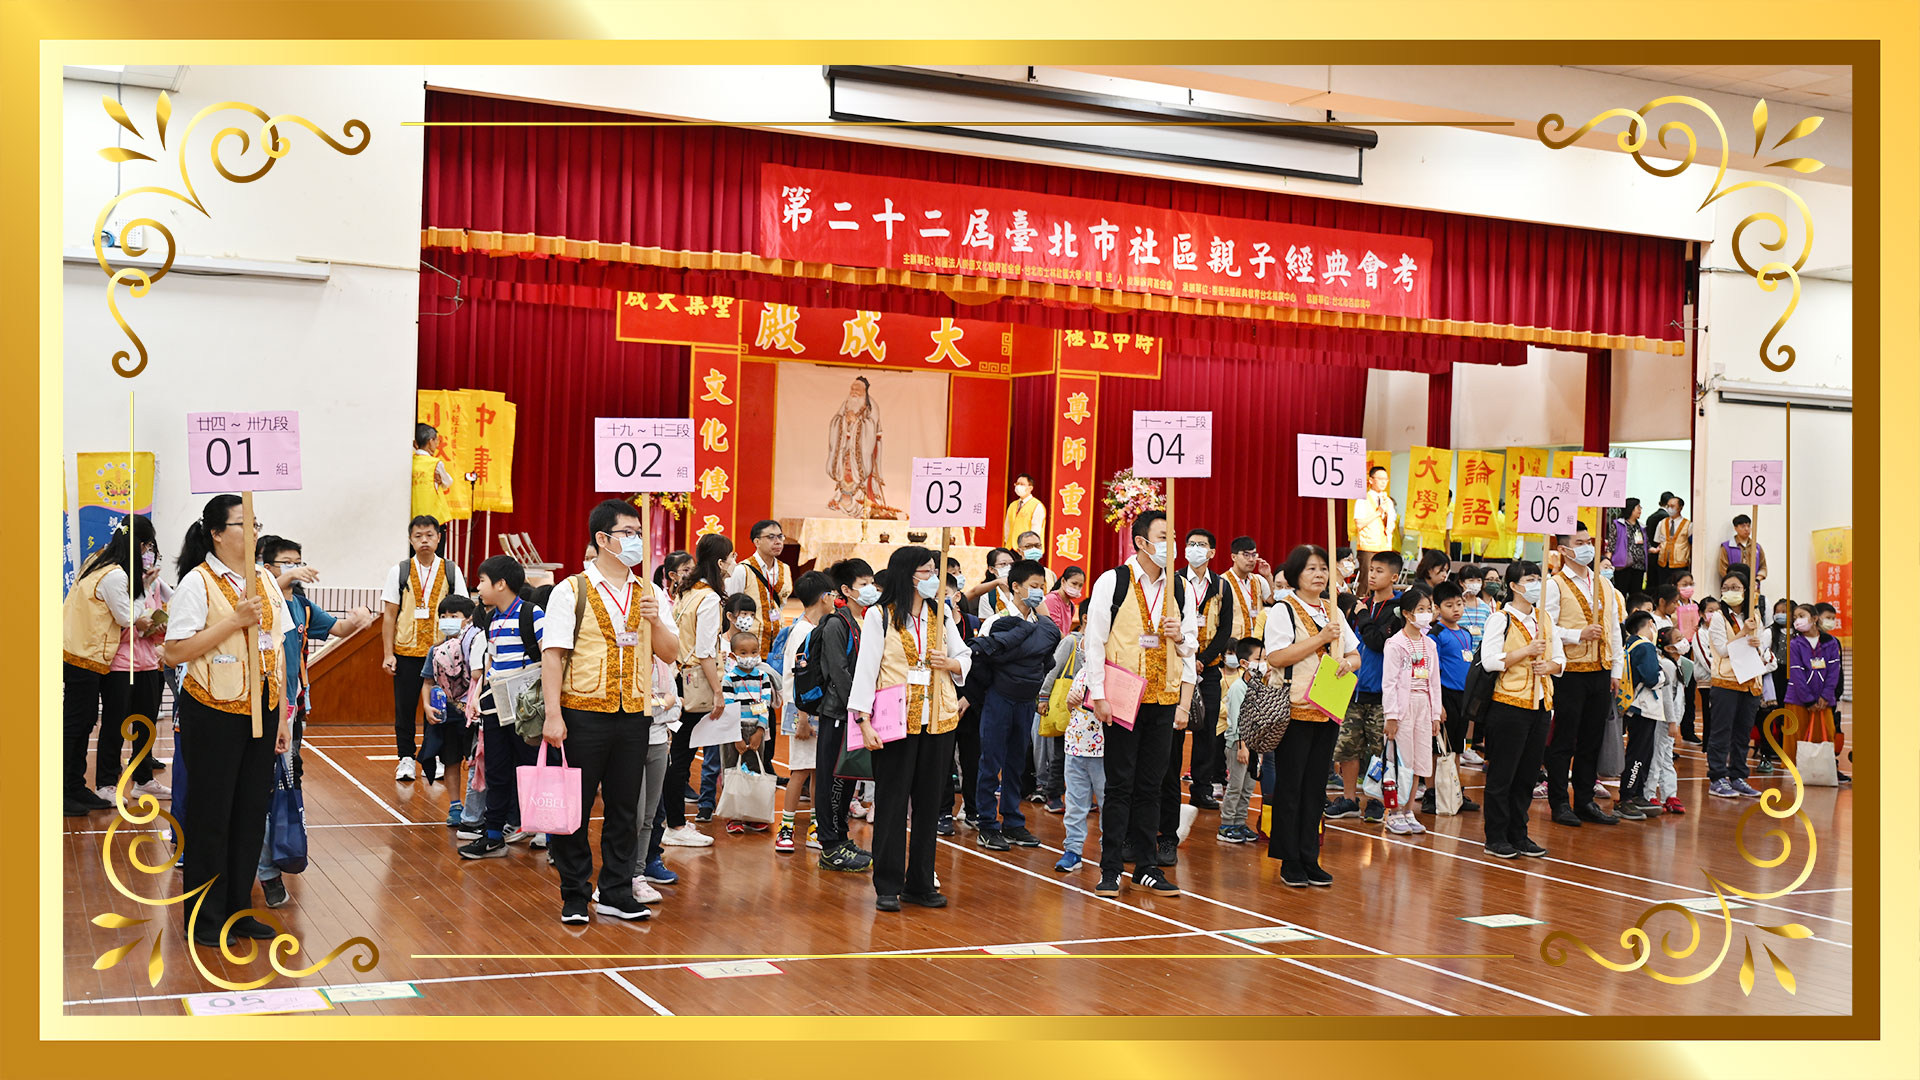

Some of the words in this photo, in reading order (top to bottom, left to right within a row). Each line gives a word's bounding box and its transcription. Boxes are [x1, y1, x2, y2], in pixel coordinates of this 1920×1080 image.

[781, 185, 1418, 293] 第二十二屆臺北市社區親子經典會考
[206, 437, 260, 477] 01
[275, 462, 289, 476] 組
[614, 442, 663, 478] 02
[676, 466, 689, 479] 組
[1147, 432, 1185, 465] 04
[1056, 391, 1092, 562] 尊師重道
[1311, 455, 1345, 487] 05
[1413, 455, 1442, 519] 大學
[1580, 472, 1608, 498] 07
[1740, 475, 1766, 497] 08
[925, 480, 963, 514] 03
[1462, 459, 1496, 525] 論語
[1530, 495, 1560, 523] 06
[529, 796, 567, 809] NOBEL
